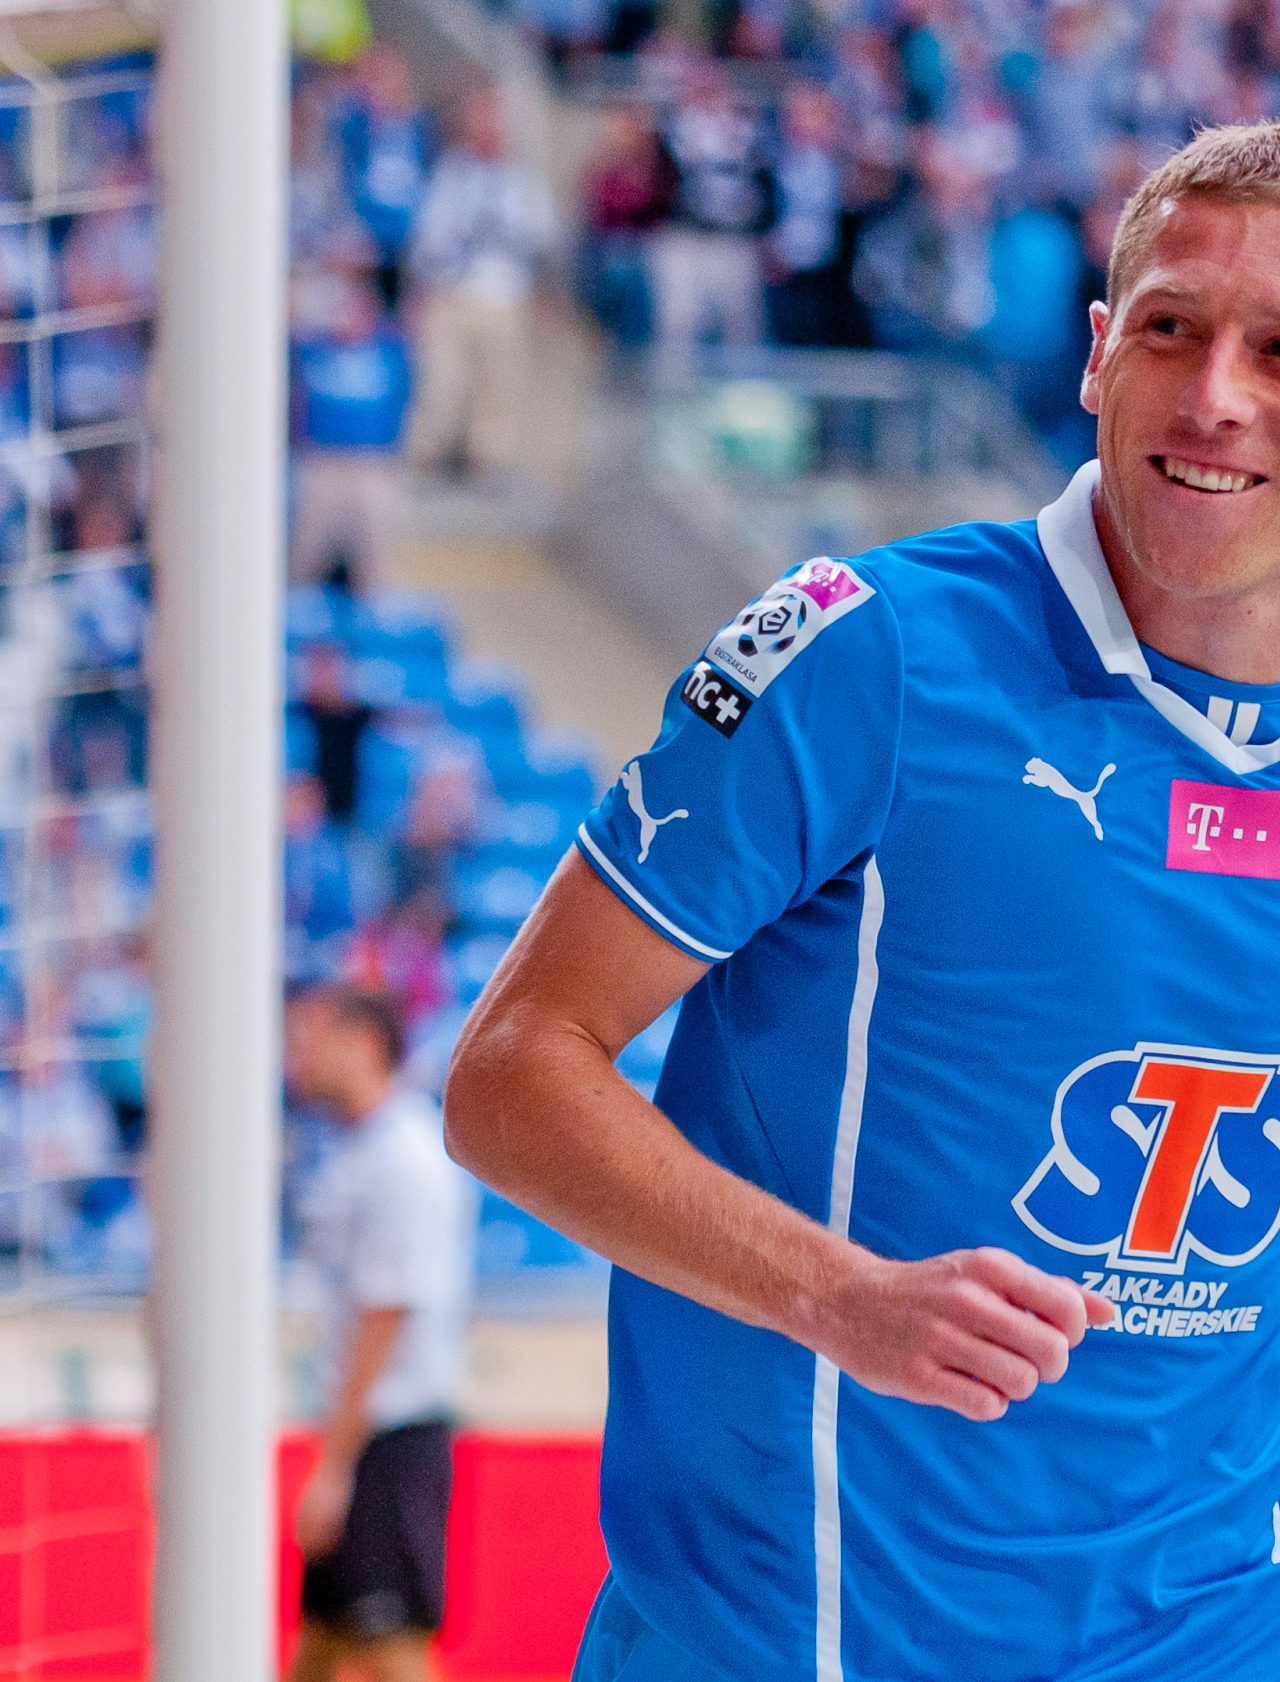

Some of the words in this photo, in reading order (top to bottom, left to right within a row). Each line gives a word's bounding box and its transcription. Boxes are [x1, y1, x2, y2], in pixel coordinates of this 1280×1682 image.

[713, 646, 758, 683] EKSTRAKLASA
[683, 660, 741, 724] nc+
[1081, 1271, 1229, 1309] ZAKŁADY
[1085, 1304, 1263, 1338] ACHERSKIE
